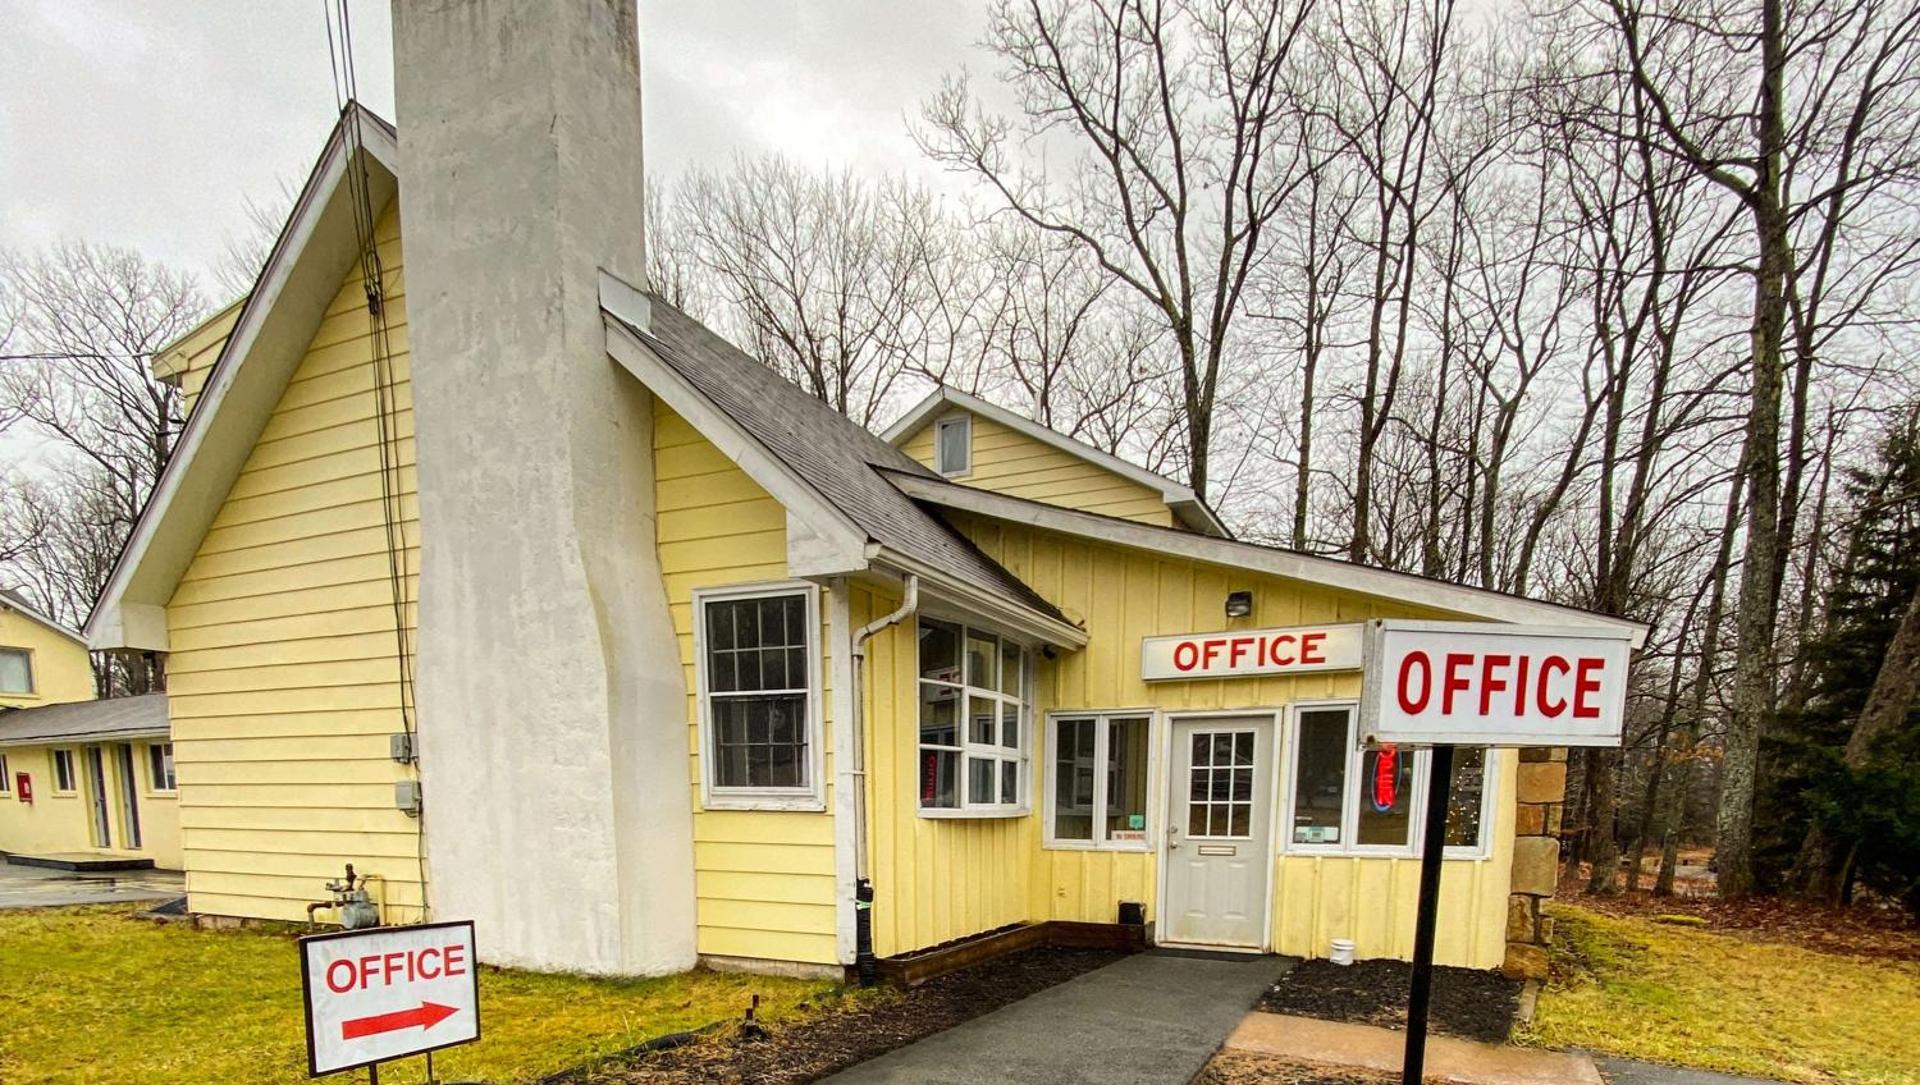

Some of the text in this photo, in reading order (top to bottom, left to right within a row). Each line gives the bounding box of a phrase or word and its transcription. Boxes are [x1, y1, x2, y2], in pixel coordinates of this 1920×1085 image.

[1173, 632, 1328, 673] OFFICE
[1396, 649, 1606, 719] OFFICE
[325, 944, 466, 994] OFFICE
